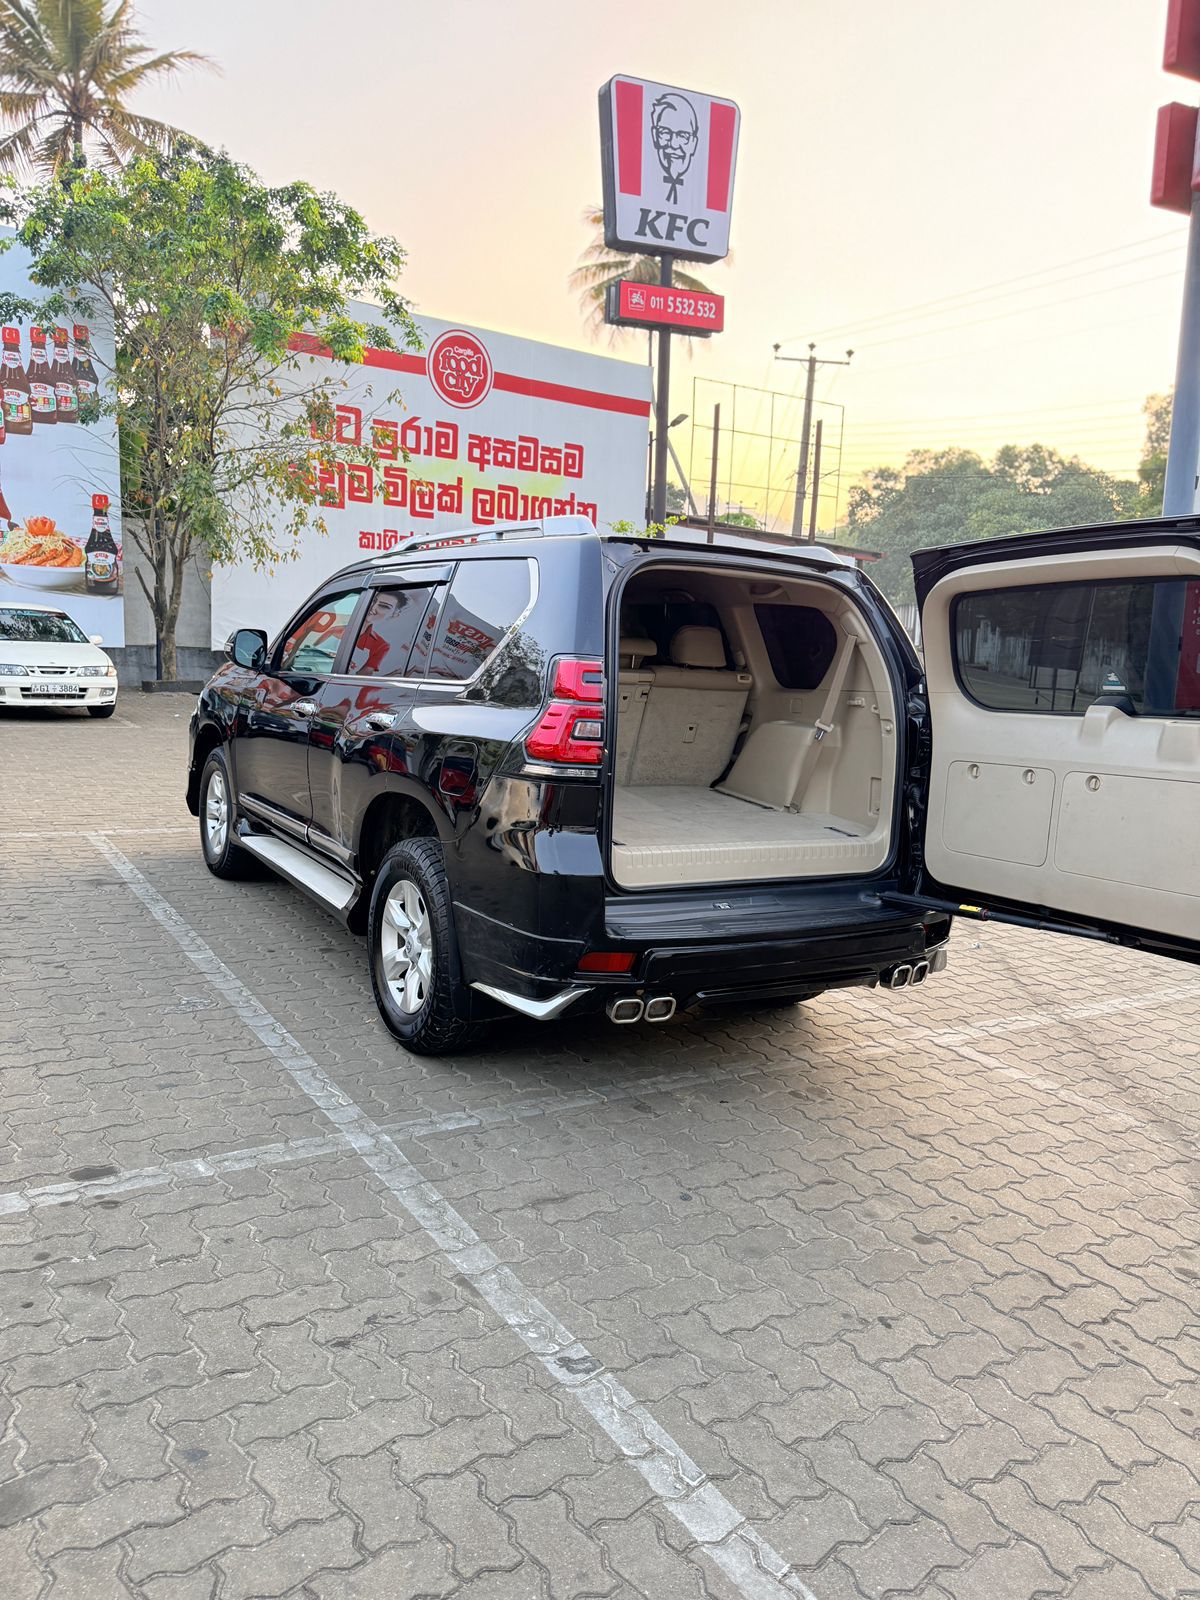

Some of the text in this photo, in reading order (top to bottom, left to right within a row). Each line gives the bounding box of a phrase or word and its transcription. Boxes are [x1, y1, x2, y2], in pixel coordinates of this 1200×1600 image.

[634, 207, 710, 247] KFC
[650, 294, 664, 311] 011
[696, 300, 716, 319] 532
[439, 347, 484, 380] food
[467, 433, 584, 479] අසමසම
[383, 465, 463, 519] මිලක්
